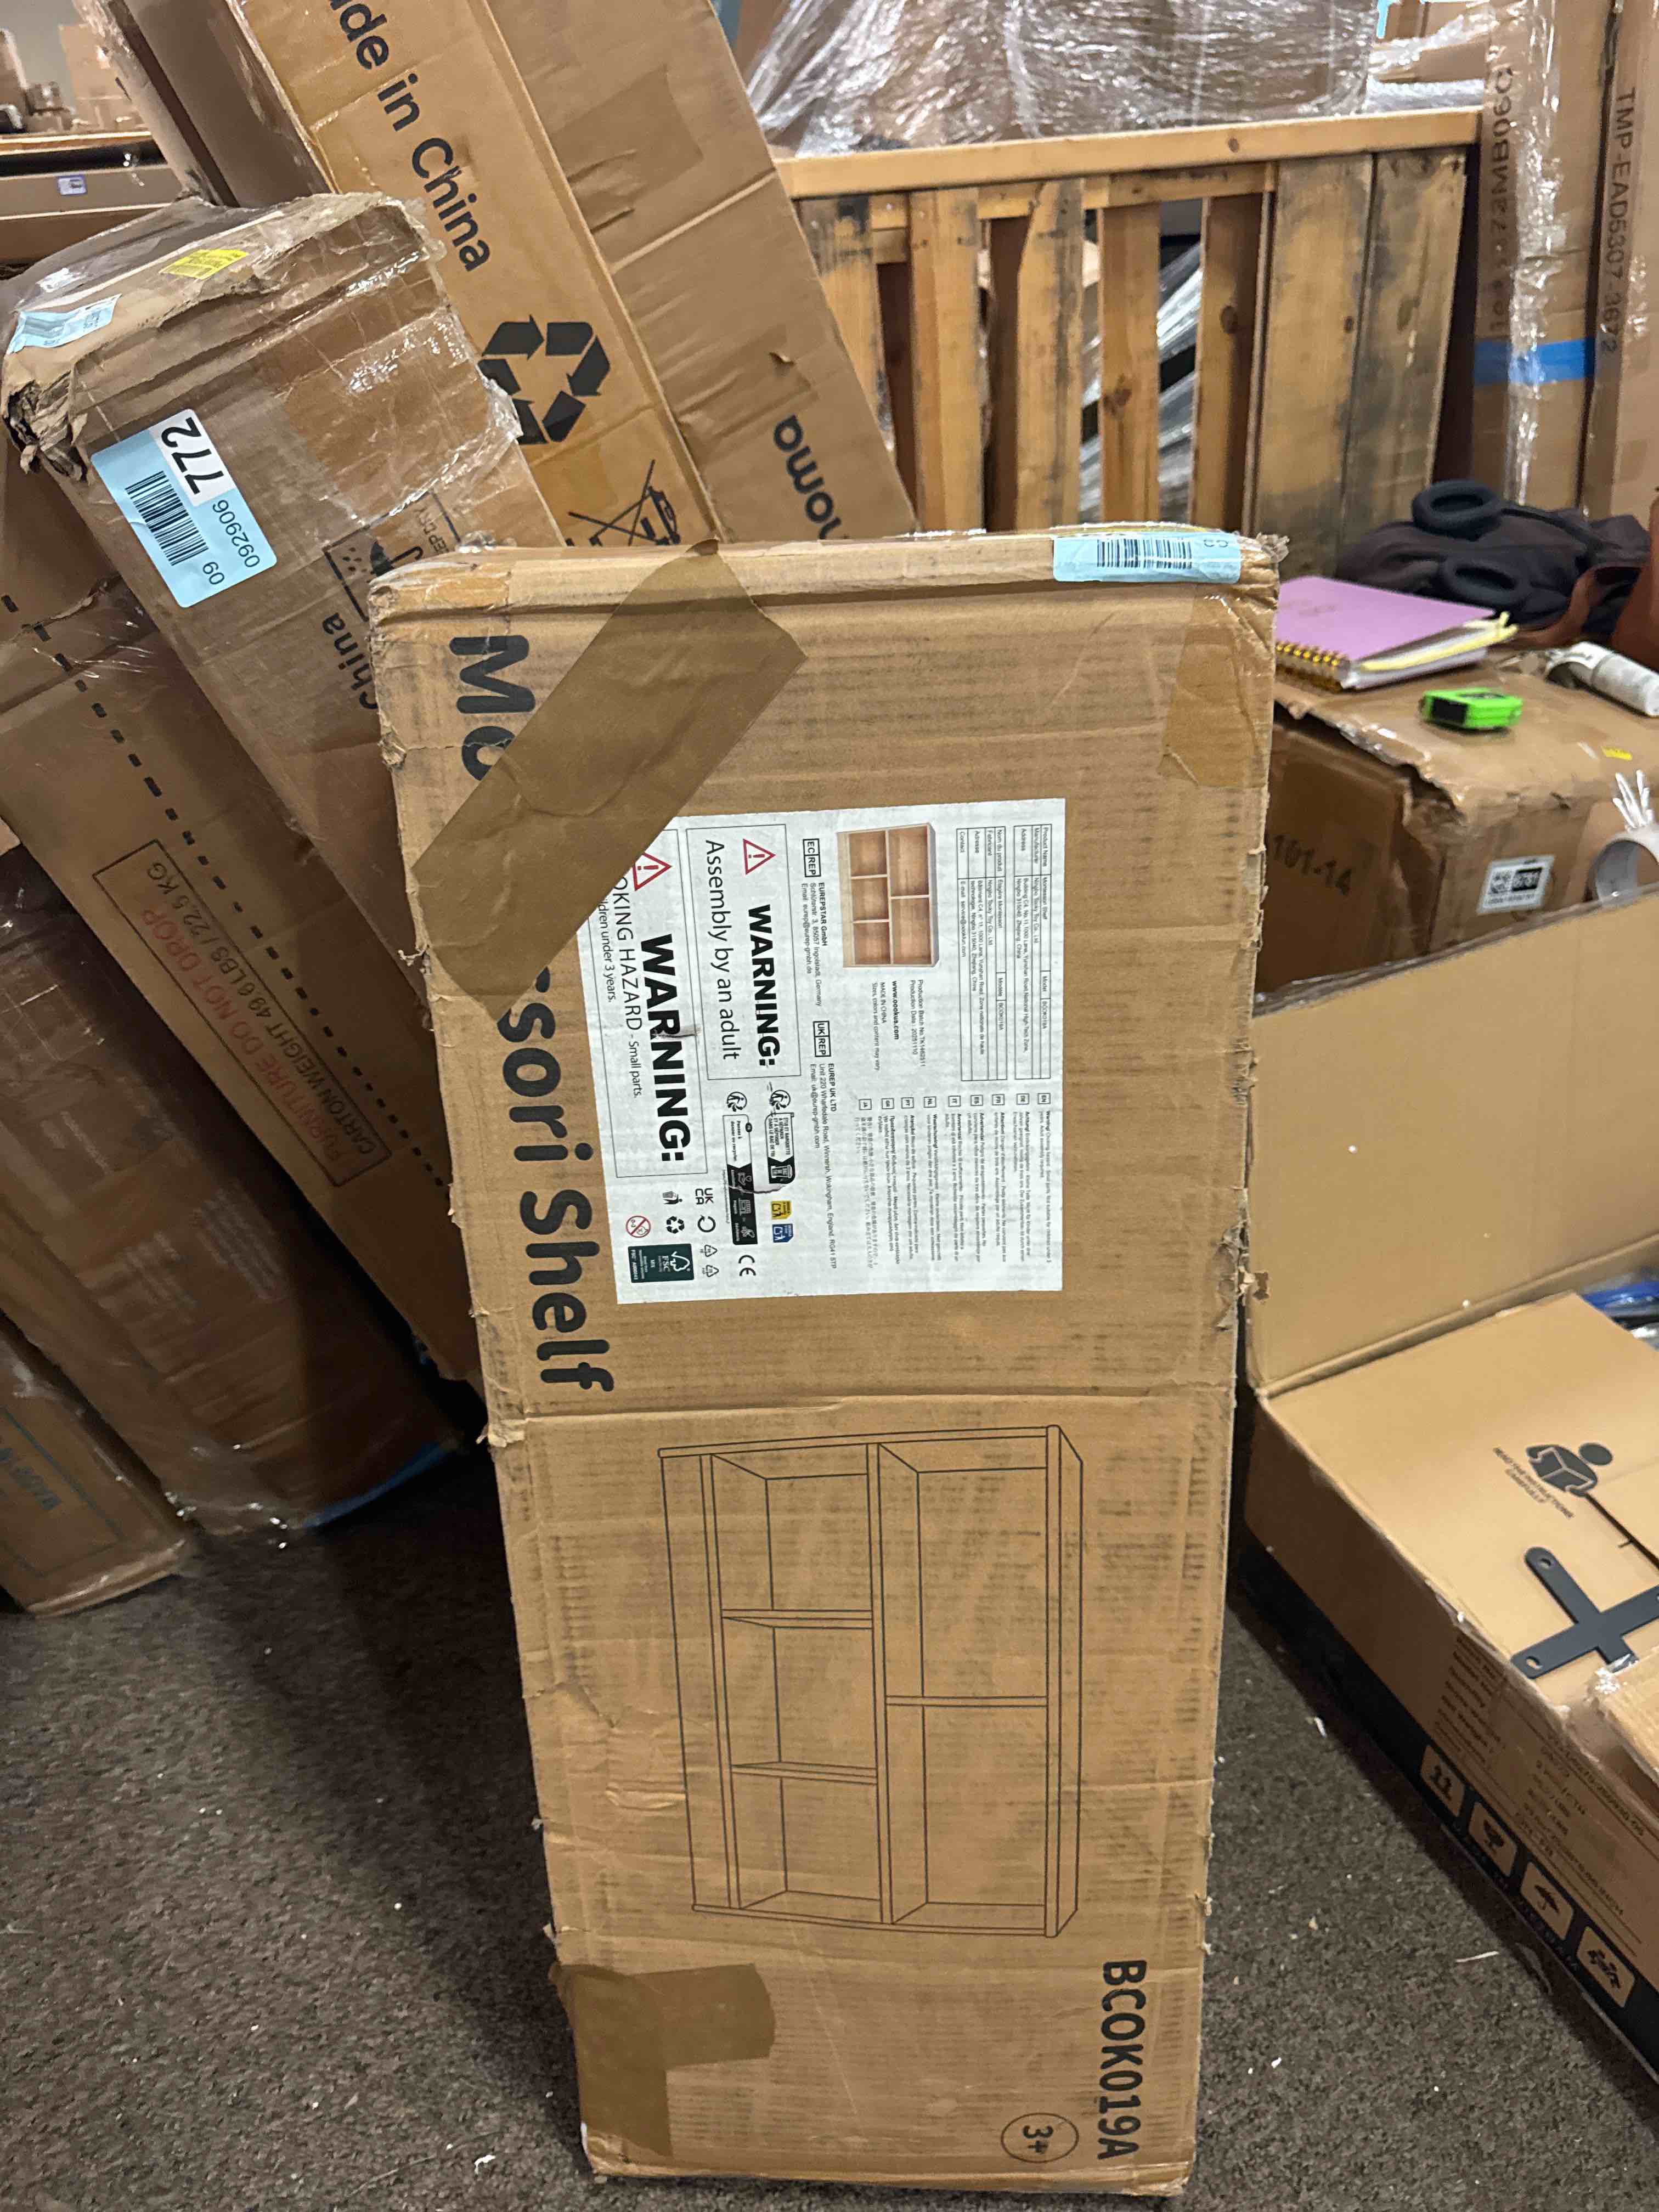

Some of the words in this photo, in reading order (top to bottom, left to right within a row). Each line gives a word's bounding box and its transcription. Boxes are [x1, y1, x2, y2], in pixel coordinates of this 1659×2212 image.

[330, 0, 389, 70] de
[377, 73, 420, 132] in
[412, 138, 490, 271] China
[161, 417, 224, 494] 772
[212, 500, 260, 568] 092906
[203, 561, 225, 585] 09
[807, 841, 815, 854] EC
[146, 861, 179, 895] KG
[707, 839, 732, 942] Assembly
[600, 931, 614, 963] under
[710, 948, 735, 973] by
[603, 973, 617, 1002] years.
[619, 949, 642, 1030] HAZARD
[717, 978, 730, 1002] an
[748, 905, 781, 1066] WARNING:
[719, 1008, 741, 1059] adult
[817, 1023, 824, 1034] UK
[268, 1024, 323, 1087] WEIGHT
[628, 1041, 640, 1068] Small
[640, 934, 691, 1161] WARNING:
[629, 1071, 643, 1098] parts.
[830, 1088, 835, 1097] UK
[321, 1088, 374, 1155] CARTON
[695, 1188, 704, 1205] CA
[704, 1188, 713, 1204] UK
[737, 1255, 756, 1276] CE
[520, 1189, 614, 1392] Shelf
[1097, 1960, 1147, 2160] BCOK019A
[1023, 2125, 1054, 2155] 3+
